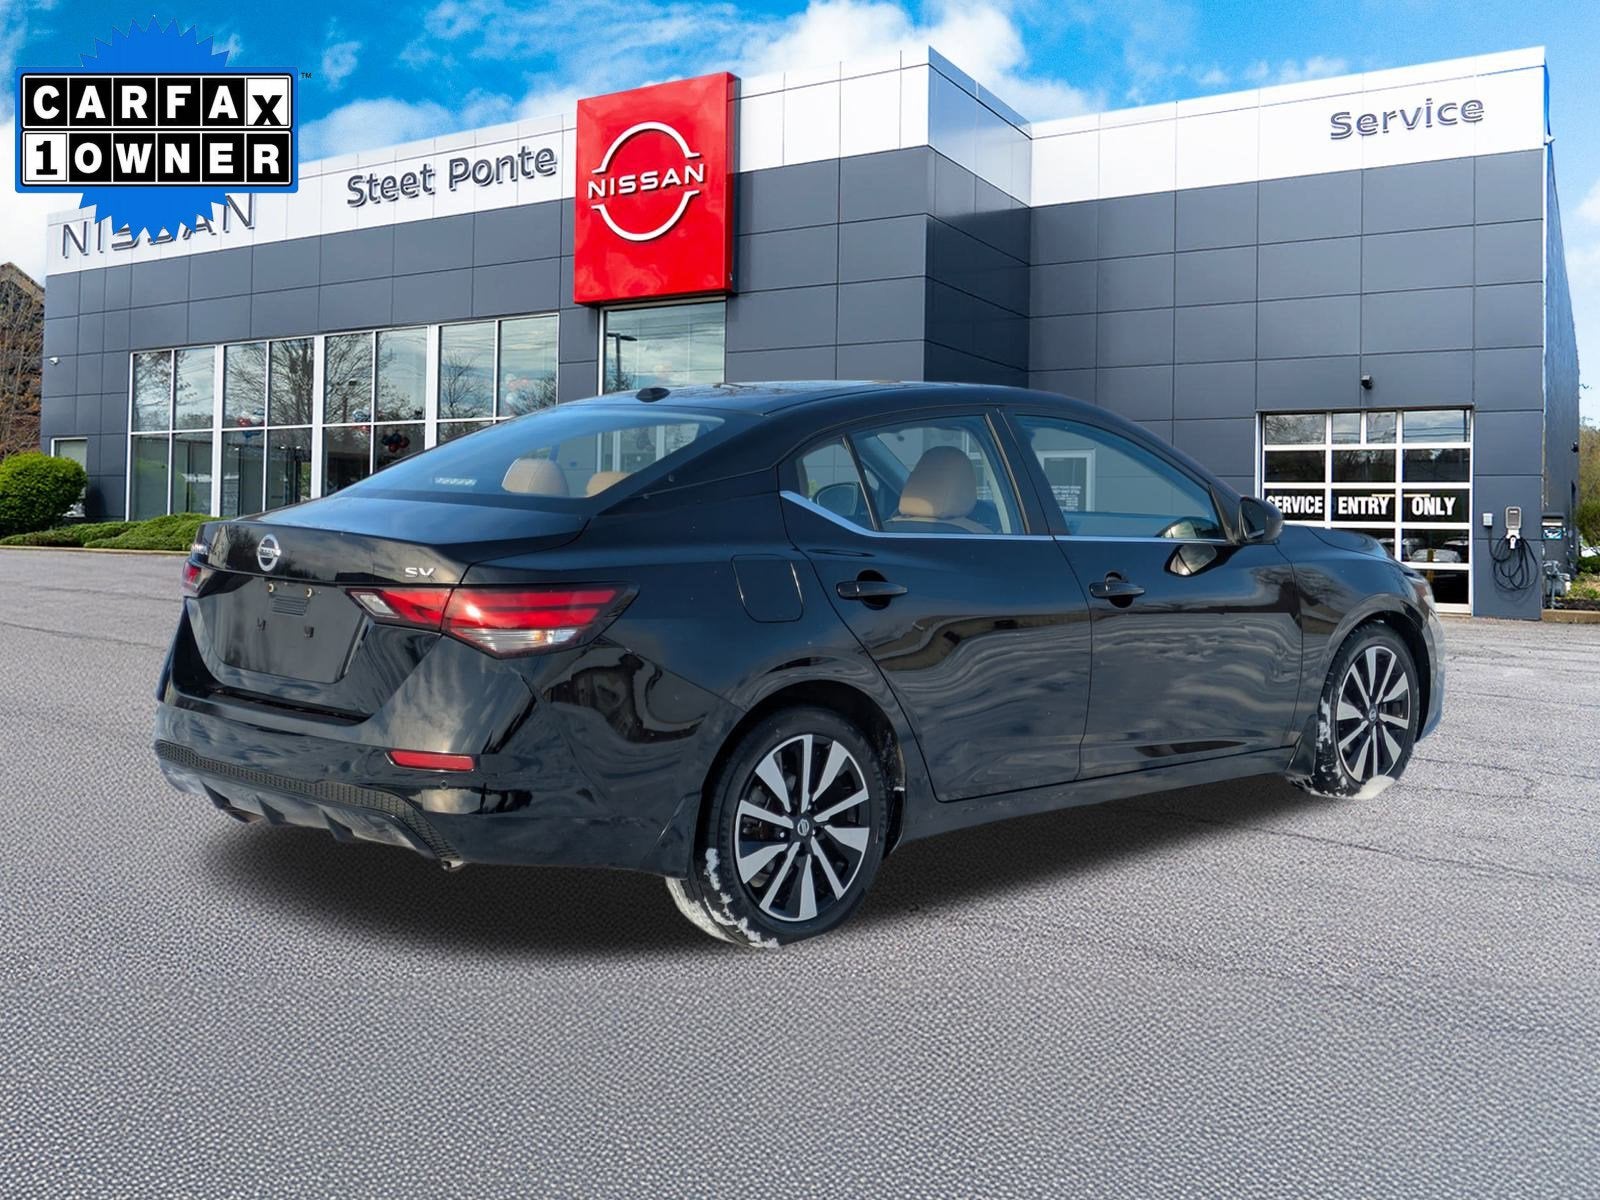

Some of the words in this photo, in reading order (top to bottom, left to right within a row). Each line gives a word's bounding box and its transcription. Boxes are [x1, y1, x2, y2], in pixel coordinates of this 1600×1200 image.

[1330, 98, 1484, 140] Service
[347, 163, 435, 207] Steet
[449, 146, 557, 191] Ponte
[588, 163, 704, 199] NISSAN
[1338, 496, 1389, 515] ENTRY
[1411, 496, 1456, 516] ONLY
[405, 567, 435, 578] SV
